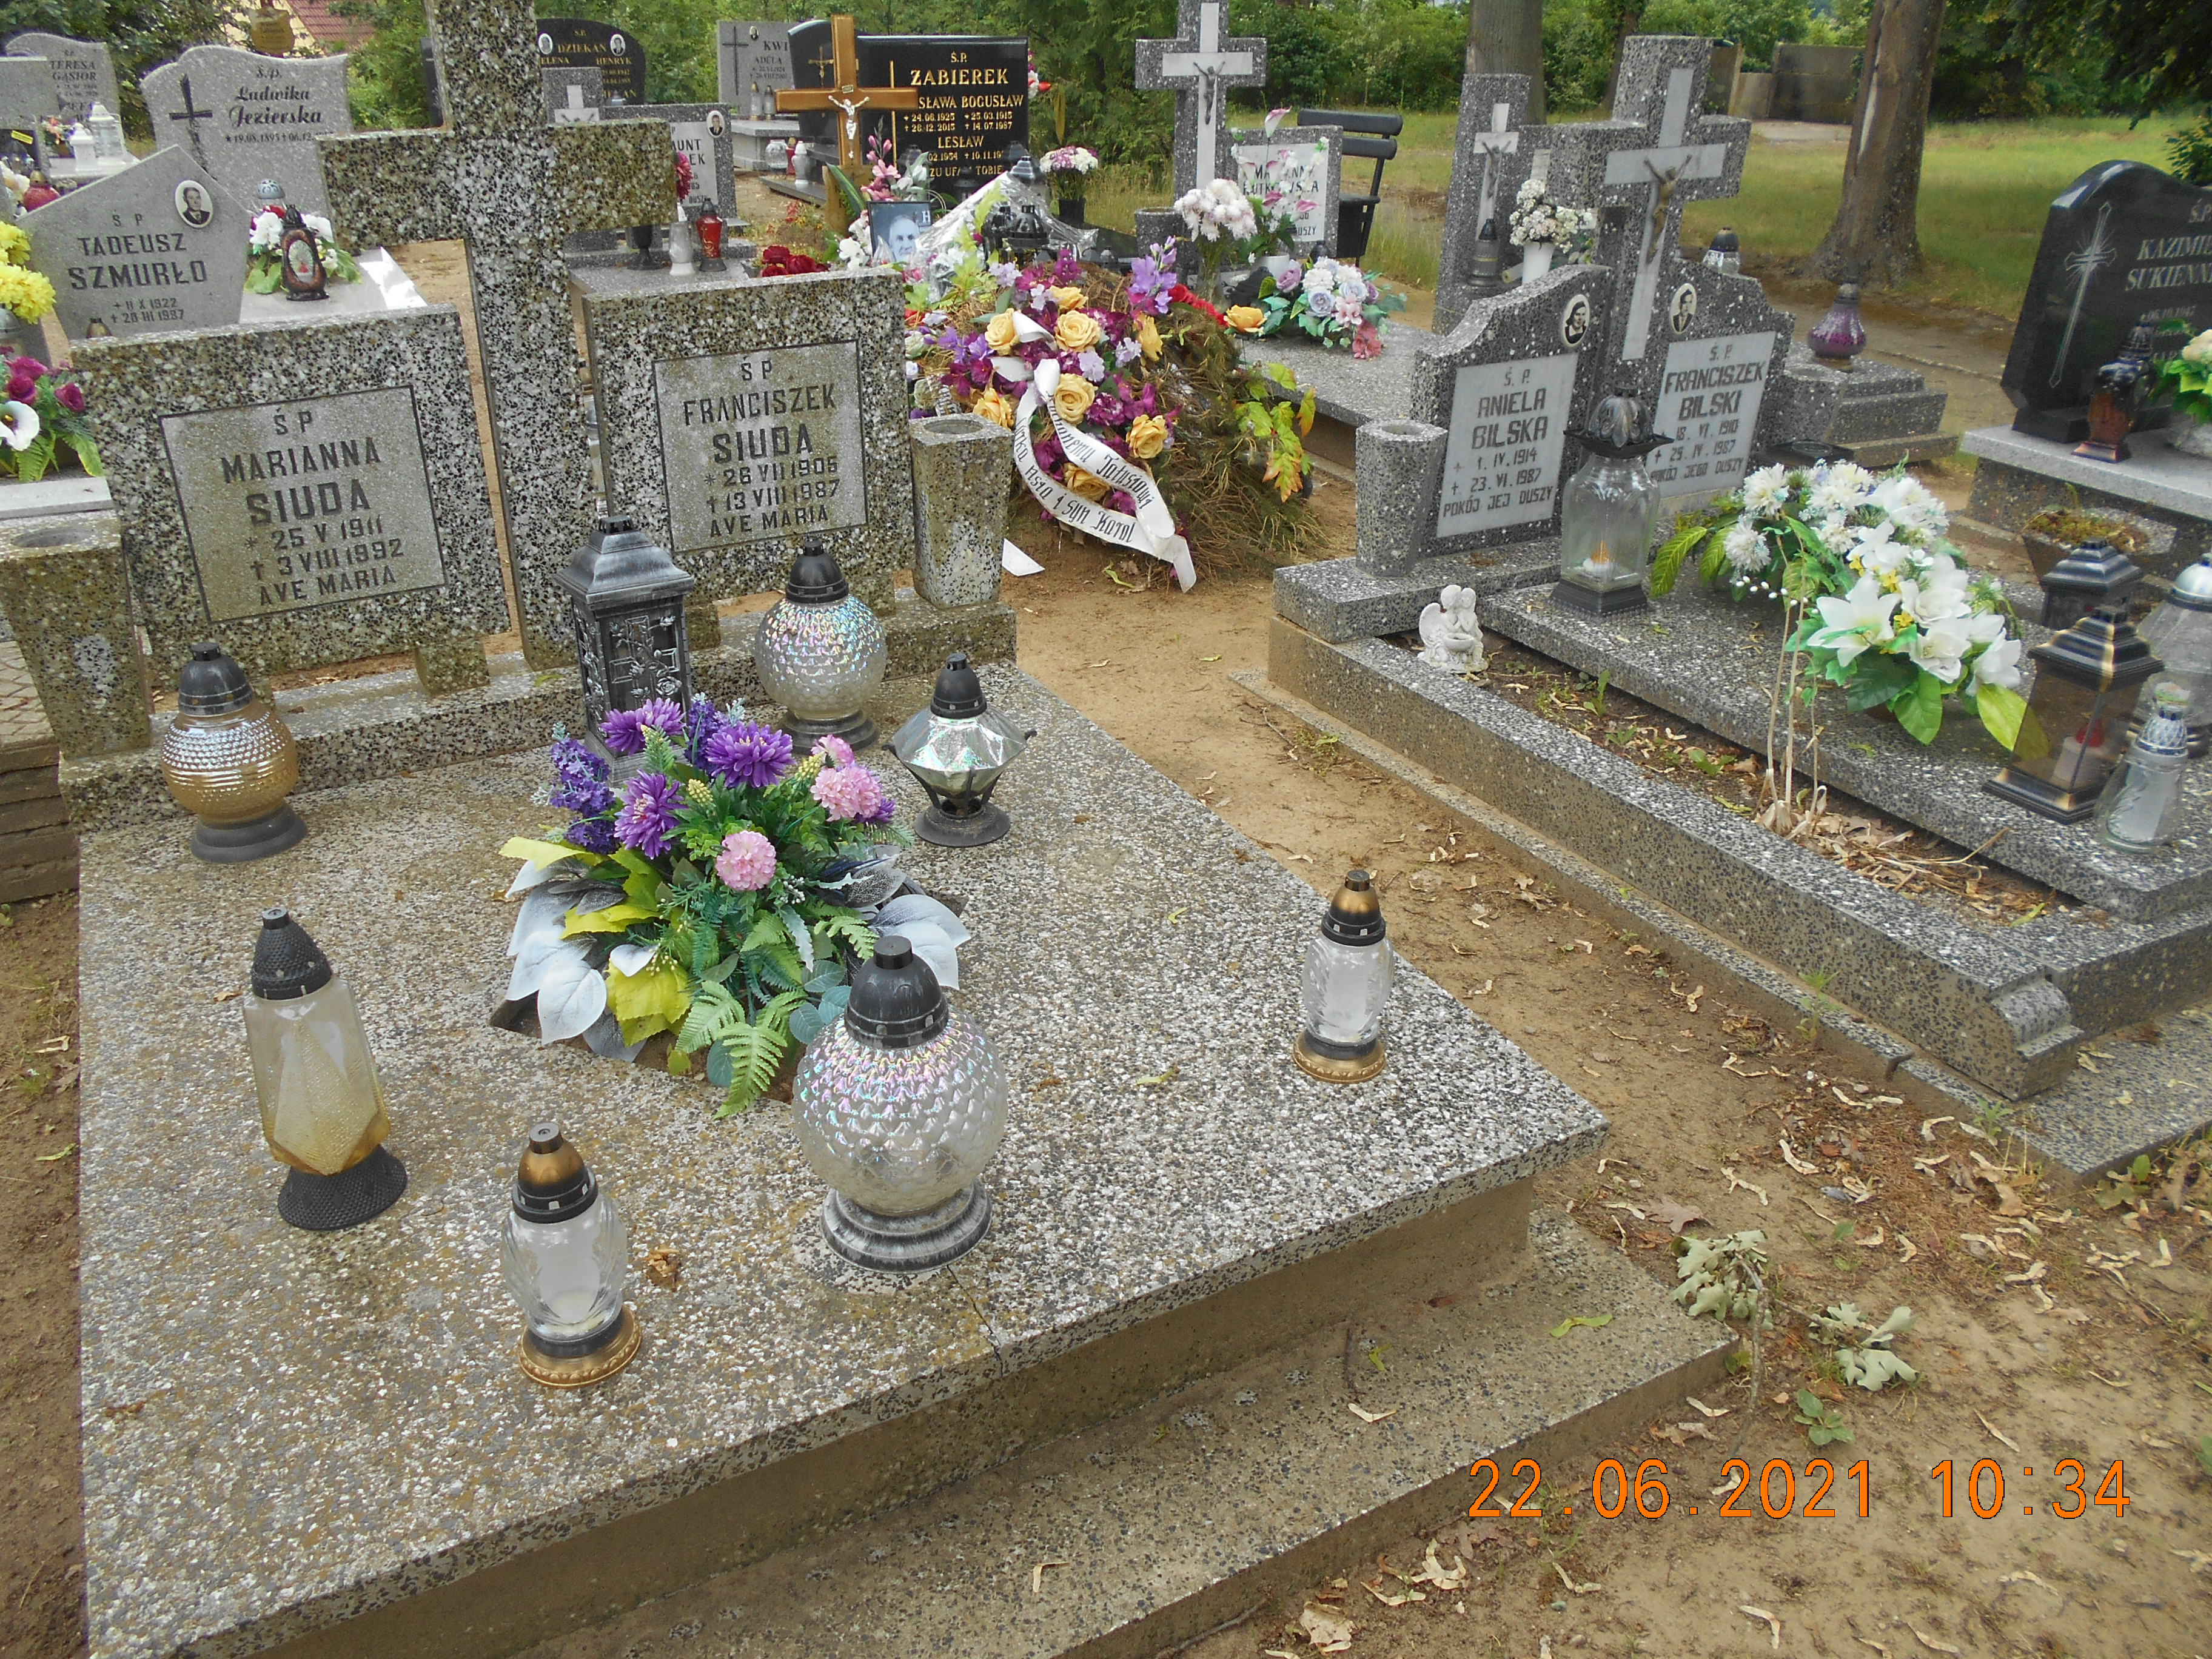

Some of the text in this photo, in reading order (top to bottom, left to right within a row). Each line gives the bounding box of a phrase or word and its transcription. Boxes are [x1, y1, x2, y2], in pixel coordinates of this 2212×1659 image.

[50, 60, 96, 69] TERESA
[951, 51, 967, 62] Ś.P.
[52, 72, 97, 82] GĄSIOR
[235, 85, 310, 101] Ludwika
[962, 94, 1024, 108] BOGUSŁAW
[229, 104, 321, 128] Jezierska
[937, 135, 984, 149] LESŁAW
[976, 165, 1003, 175] TOBIE
[135, 213, 142, 226] P
[1297, 226, 1316, 236] USZY
[77, 233, 187, 256] TADEUSZ
[68, 260, 208, 290] SZMURŁO
[142, 311, 155, 322] III
[158, 309, 184, 321] 1987
[150, 298, 178, 309] 1922
[762, 360, 773, 380] P
[1664, 361, 1766, 394] FRANCISZEK
[683, 383, 837, 426] FRANCISZEK
[1477, 387, 1547, 418] ANIELA
[1678, 390, 1742, 421] BILSKI
[299, 411, 313, 433] P
[1472, 416, 1549, 450] BILSKA
[712, 423, 814, 464] SIUDA
[221, 437, 382, 484] MARIANNA
[723, 455, 839, 487] 26 VII 1905
[1715, 457, 1744, 474] DUSZY
[726, 478, 840, 512] 13 VIII 1987
[1096, 454, 1155, 509] Tatusiowi
[246, 478, 371, 527] SIUDA
[1443, 486, 1553, 517] POKÓJ JEJ DUSZY
[271, 514, 383, 551] 25 V 1911
[710, 504, 829, 538] AVE MARIA
[1062, 499, 1092, 525] Syn
[1091, 510, 1136, 543] Karol
[276, 538, 404, 577] 3 VIII 1992
[259, 565, 397, 606] AVE MARIA
